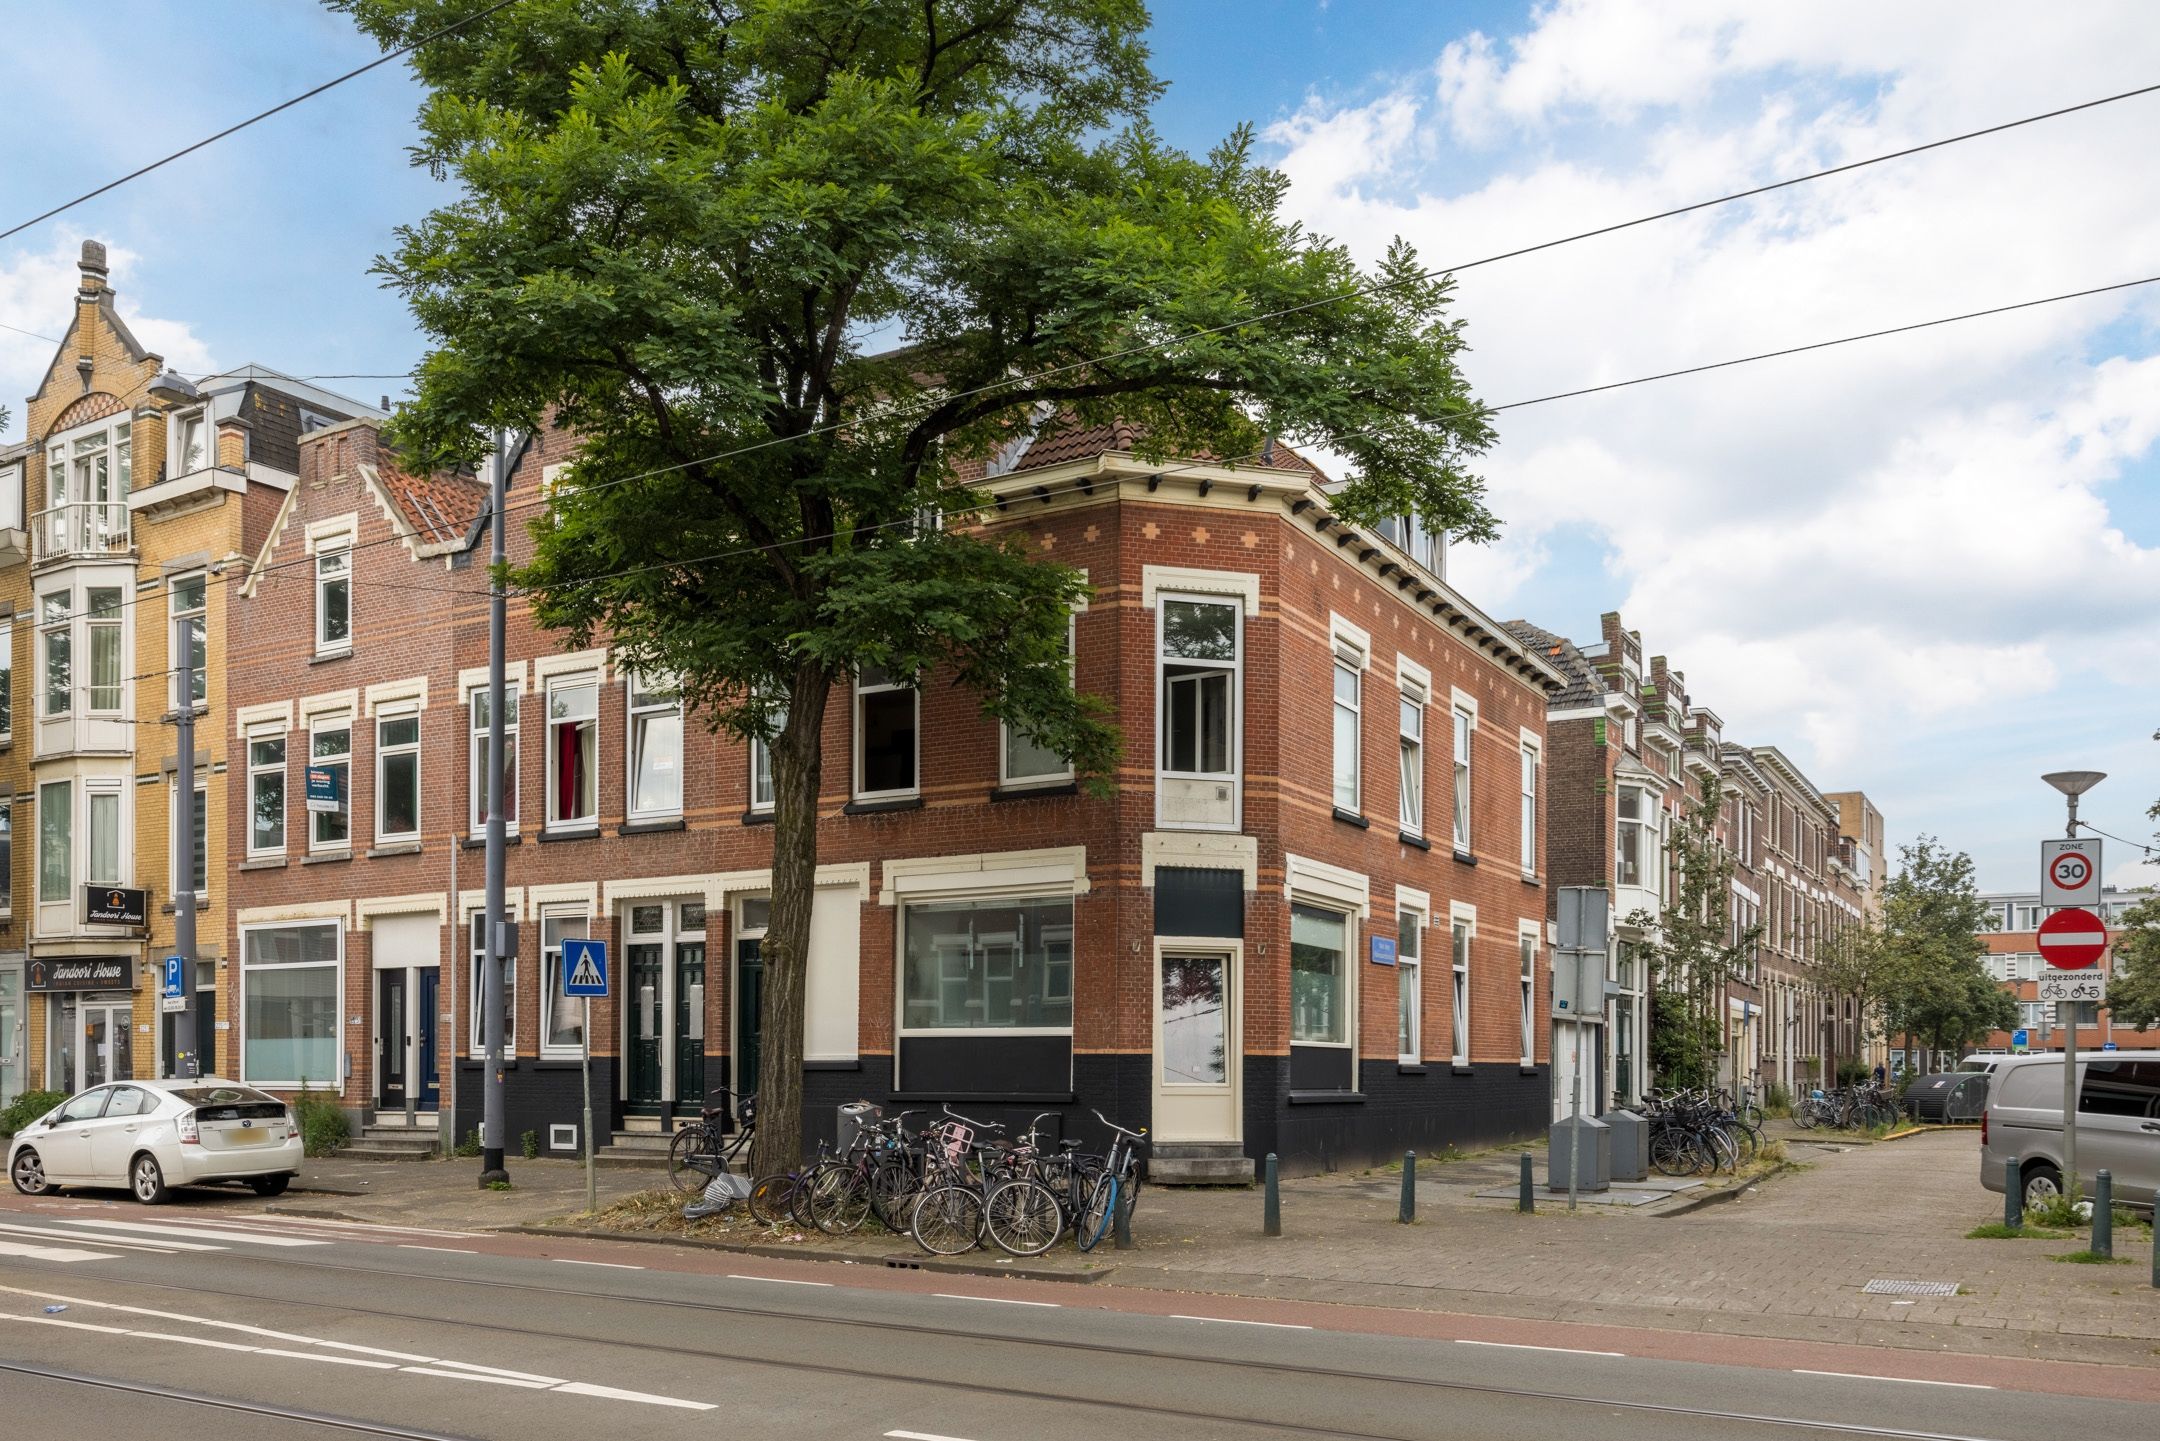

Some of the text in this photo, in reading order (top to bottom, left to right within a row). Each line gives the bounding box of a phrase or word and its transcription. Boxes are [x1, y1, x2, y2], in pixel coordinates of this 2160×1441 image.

[2059, 843, 2084, 851] ZONE
[2058, 864, 2085, 879] 30
[90, 910, 120, 919] Tandoori
[120, 912, 142, 921] House
[53, 962, 121, 979] Tandoori House
[168, 960, 177, 981] P
[2038, 972, 2103, 983] uitgezonderd
